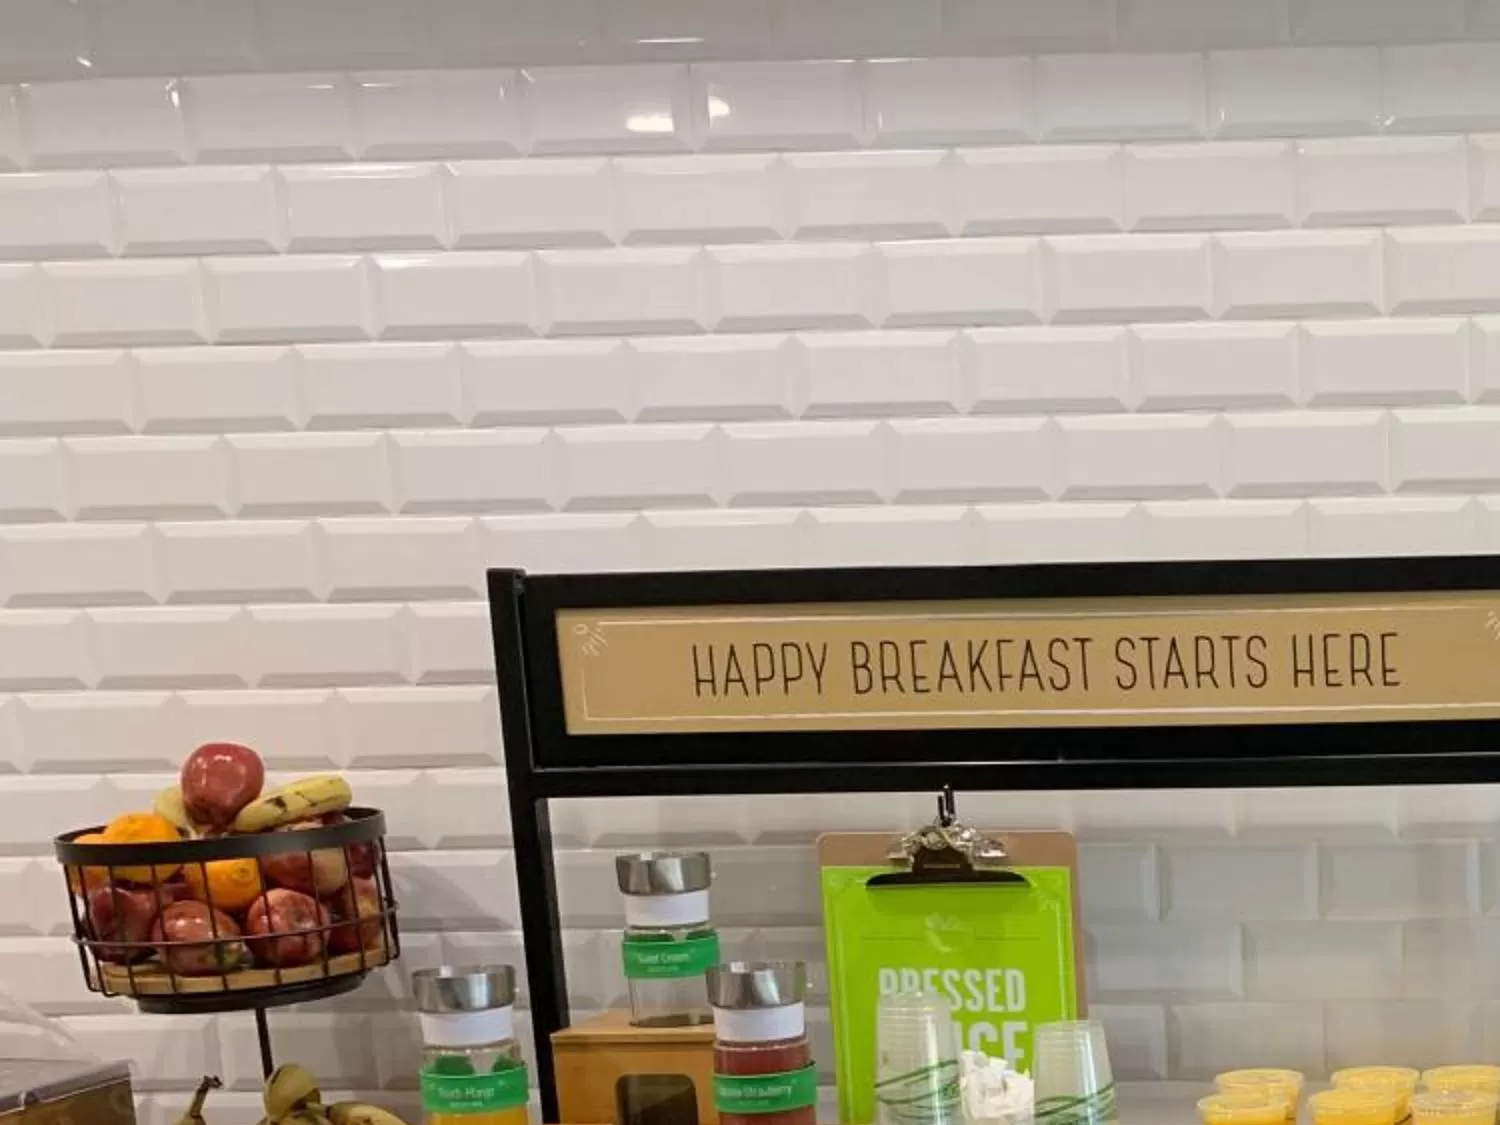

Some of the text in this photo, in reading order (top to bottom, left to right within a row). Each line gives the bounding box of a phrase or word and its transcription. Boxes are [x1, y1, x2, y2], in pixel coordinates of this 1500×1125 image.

[692, 631, 1401, 698] HAPPY BREAKFAST STARTS HERE
